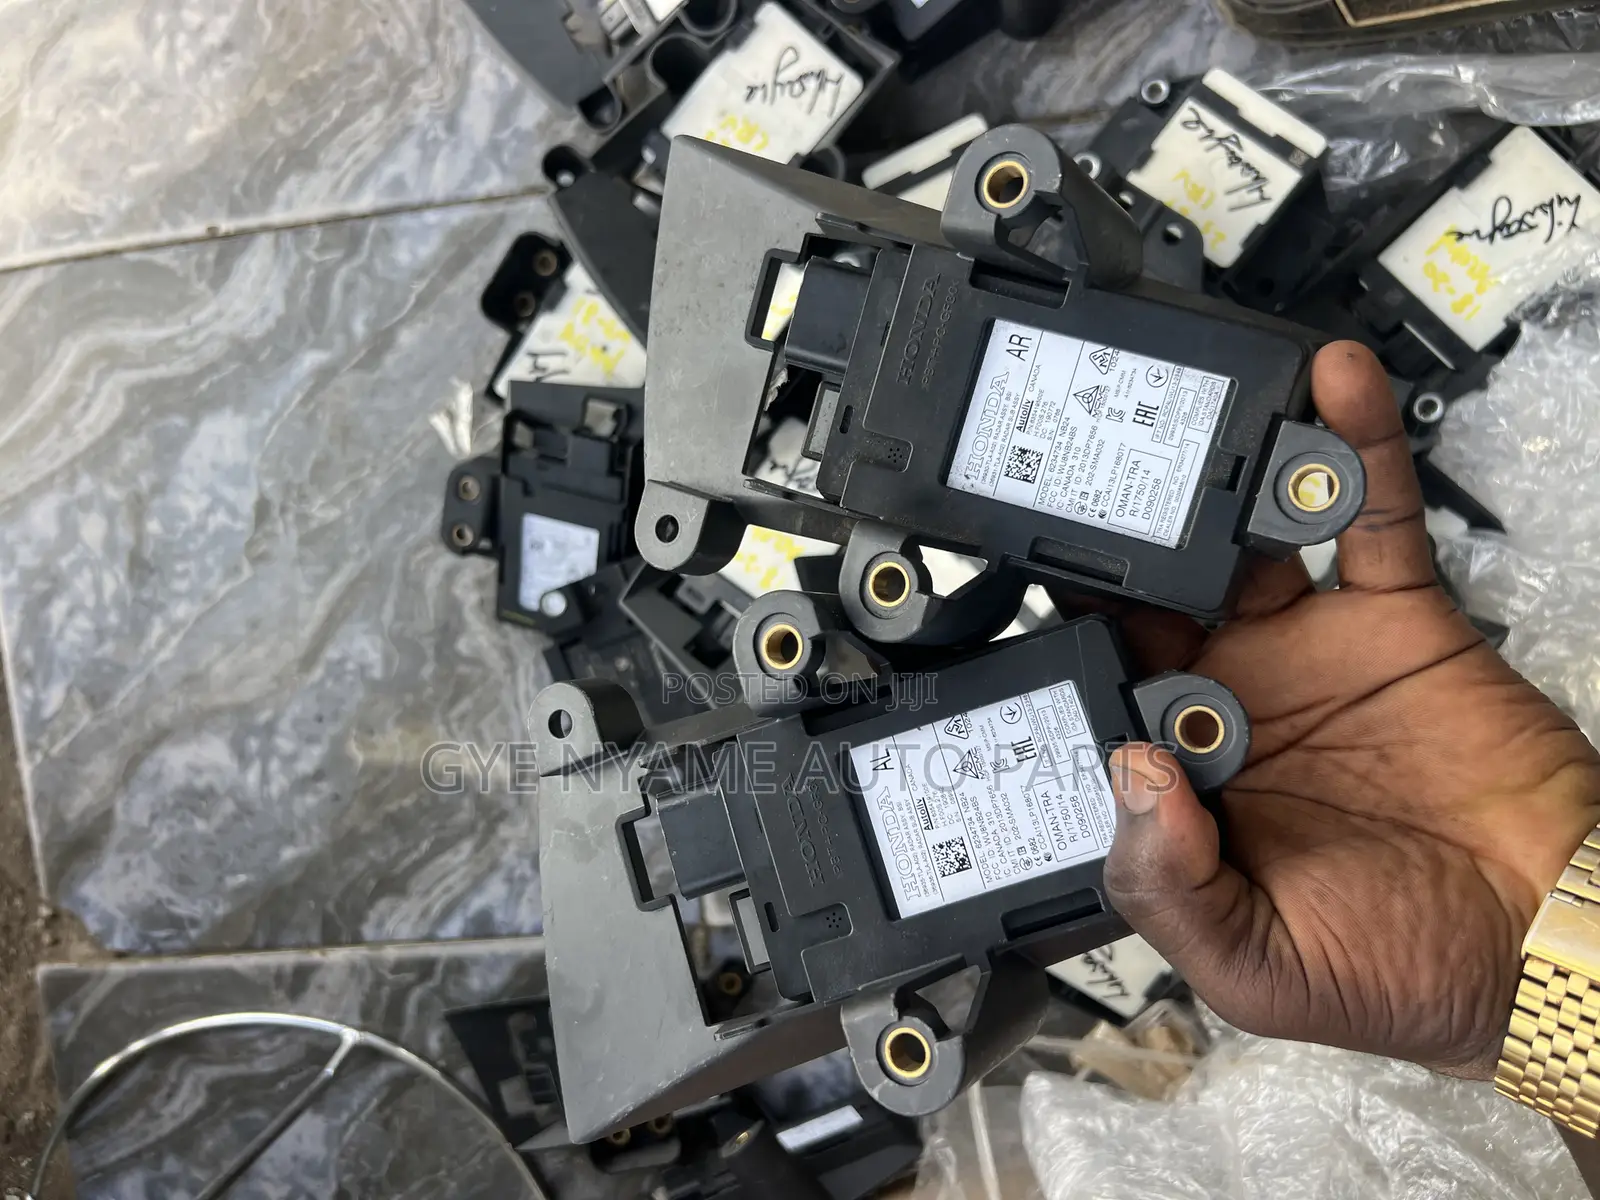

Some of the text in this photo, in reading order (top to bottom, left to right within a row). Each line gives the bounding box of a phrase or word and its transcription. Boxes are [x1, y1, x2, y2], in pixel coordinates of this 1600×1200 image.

[897, 272, 941, 384] HONDA
[1005, 333, 1032, 361] AR
[1109, 349, 1120, 371] 1024
[1001, 422, 1011, 442] RADAR
[1007, 409, 1015, 422] SUB
[1011, 392, 1020, 409] ASSY
[1015, 364, 1041, 432] Autoliv CANADA
[963, 371, 1009, 479] HONDA
[993, 419, 1003, 440] RADAR
[1048, 440, 1062, 472] 6234734
[1059, 416, 1070, 437] NB24
[1046, 490, 1057, 507] FCC
[1057, 425, 1077, 474] WU8NB24BS
[1077, 424, 1097, 472] 2013DP7656
[1059, 464, 1075, 497] CANADA
[1071, 445, 1081, 460] 310
[1115, 459, 1141, 517] OMAN-TRA
[1090, 489, 1102, 507] 0682
[1128, 469, 1150, 517] R/1750/14
[1141, 477, 1162, 520] D090258
[1159, 488, 1174, 523] REGISTERED
[869, 748, 894, 772] AL
[903, 798, 913, 814] ASSY
[905, 763, 931, 831] Autoliv CANADA
[958, 791, 970, 812] NB24
[984, 811, 995, 826] 310
[985, 784, 1008, 832] 2013DP7656
[1055, 793, 1078, 842] R/1750/14
[1069, 795, 1091, 838] D090258
[1087, 797, 1105, 832] REGISTERED
[779, 772, 825, 886] HONDA
[904, 830, 915, 851] RADAR
[912, 827, 924, 848] RADAR
[966, 816, 982, 849] 6234734
[969, 795, 991, 846] WU8NB24BS
[1040, 790, 1067, 850] OMAN-TRA
[876, 785, 921, 900] HONDA
[990, 829, 1007, 864] CANADA
[1027, 836, 1039, 855] 0682
[991, 861, 1002, 880] FCC
